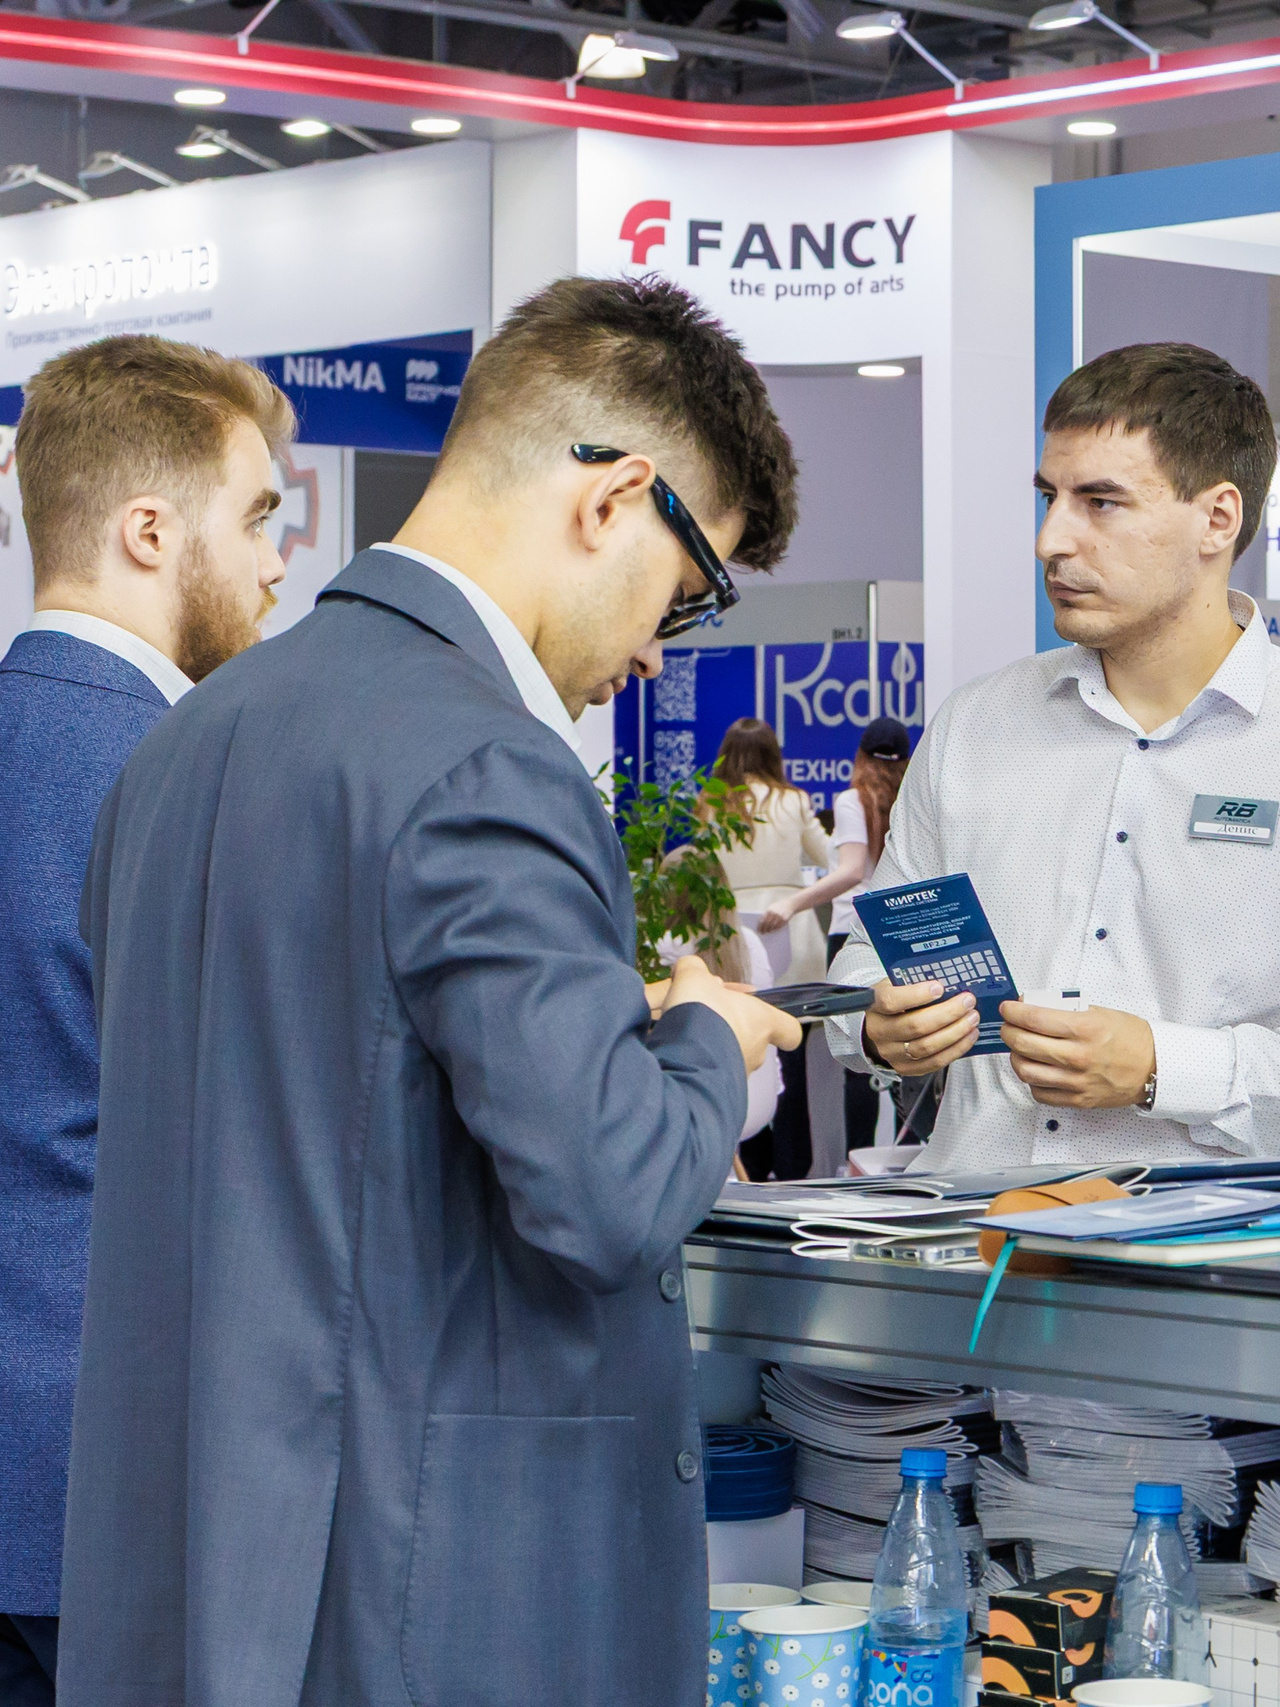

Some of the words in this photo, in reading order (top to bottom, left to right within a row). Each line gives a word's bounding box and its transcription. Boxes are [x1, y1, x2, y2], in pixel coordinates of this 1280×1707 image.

[687, 214, 917, 270] FANCY
[730, 278, 766, 296] the
[775, 281, 836, 300] pump
[843, 277, 864, 296] of
[870, 274, 904, 293] arts
[283, 356, 387, 394] NikMA
[1216, 801, 1258, 818] RB
[1217, 824, 1258, 835] Денис
